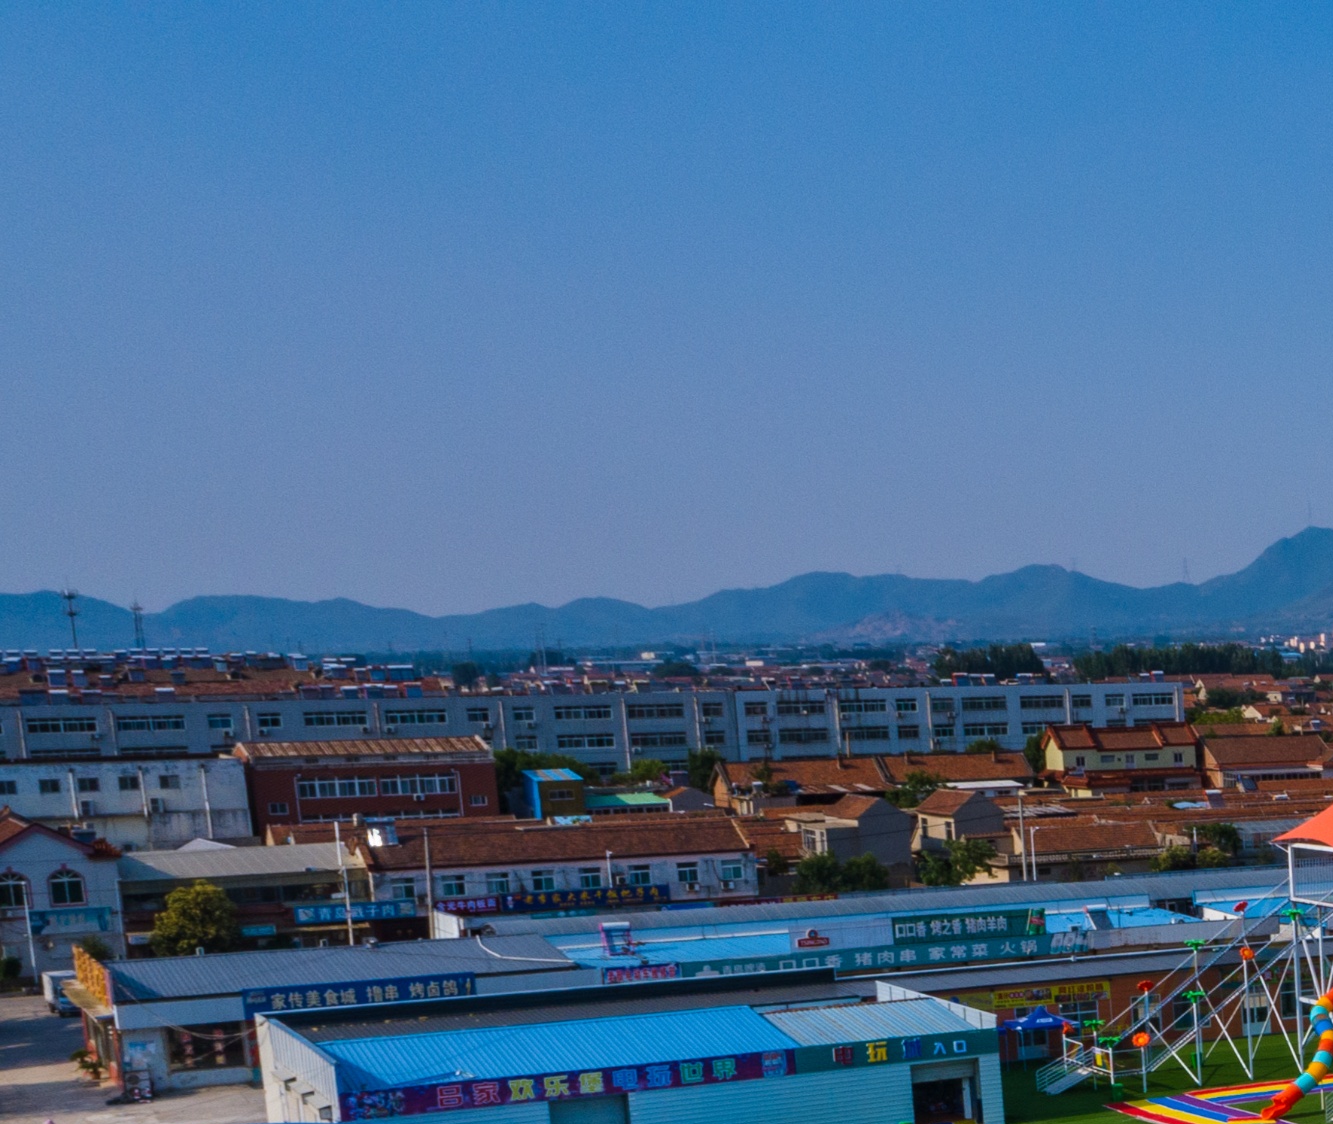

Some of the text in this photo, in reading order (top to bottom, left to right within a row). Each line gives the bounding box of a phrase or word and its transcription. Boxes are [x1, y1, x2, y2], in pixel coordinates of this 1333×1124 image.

[895, 921, 927, 938] 口口香
[855, 950, 917, 967] 猪肉串
[928, 943, 988, 961] 家常菜
[1000, 940, 1038, 955] 火锅
[271, 987, 357, 1010] 家传美食城
[437, 1058, 737, 1108] 吕家欢乐堡电玩世界
